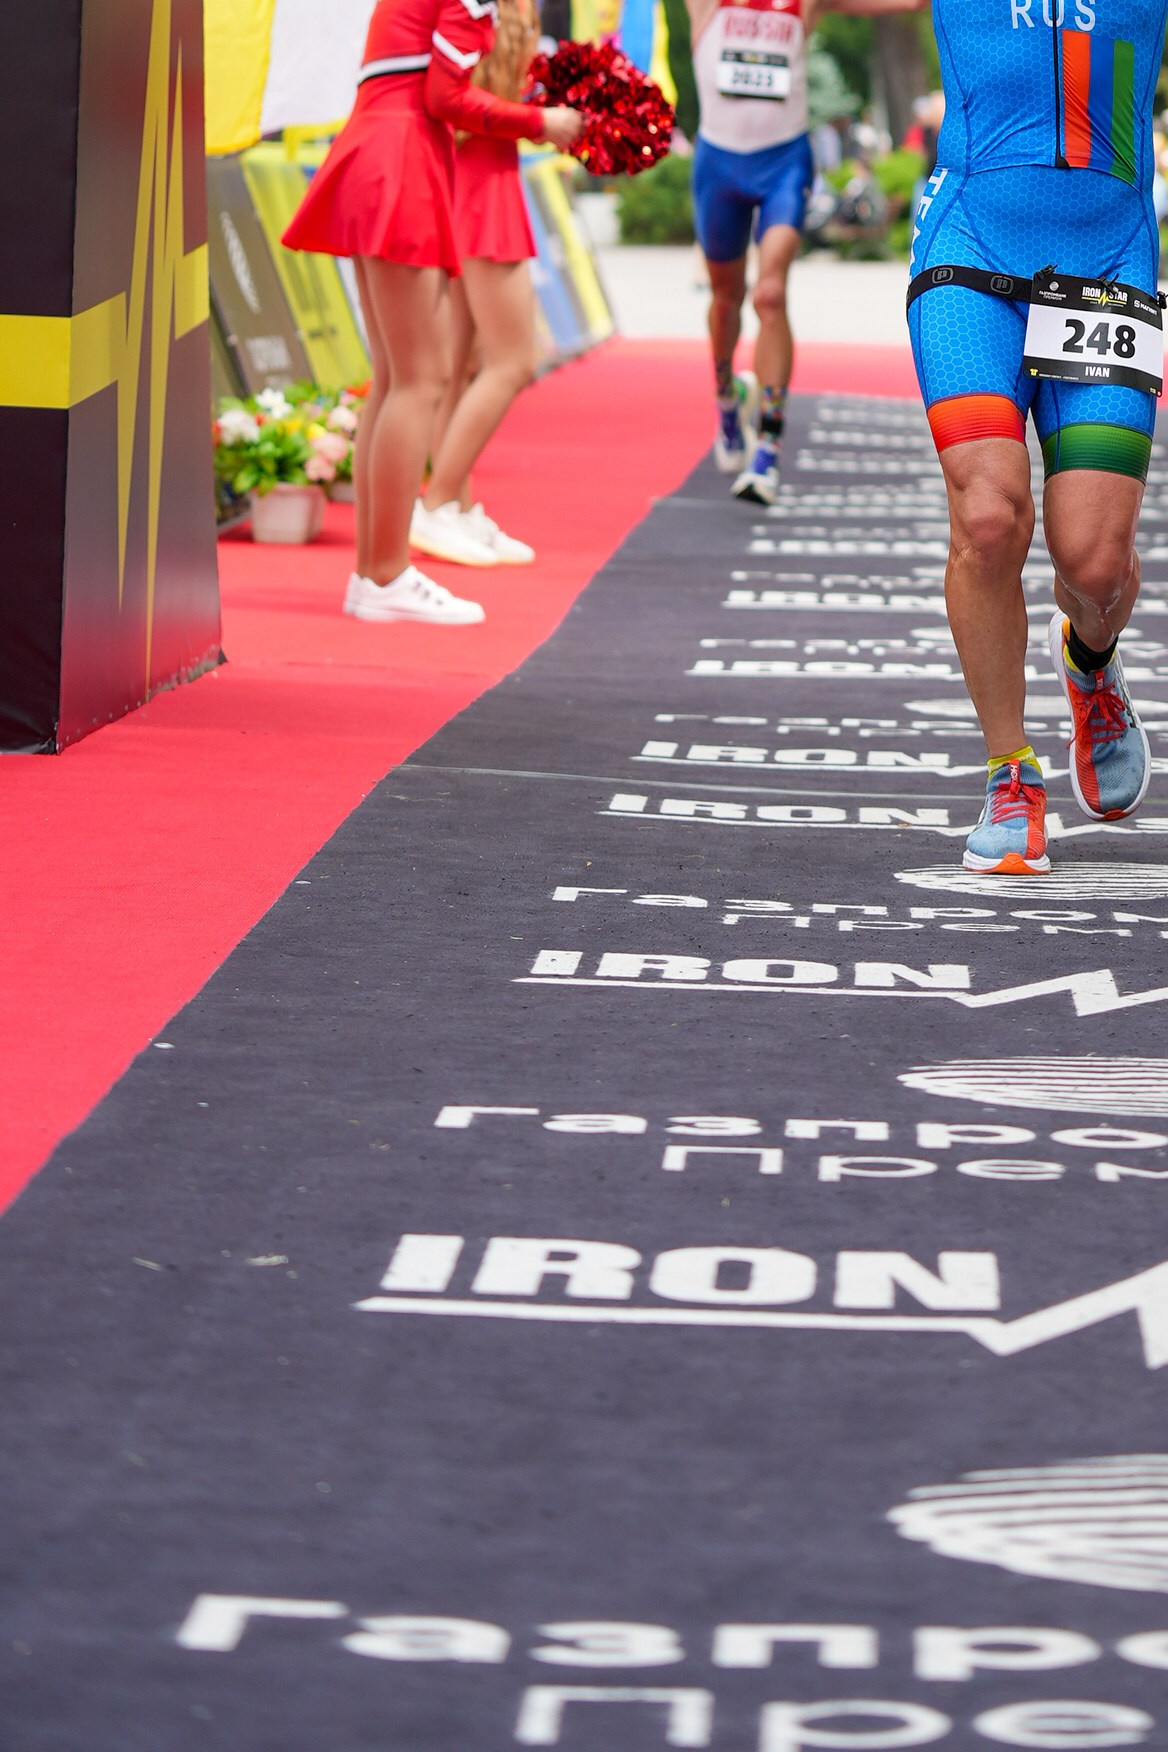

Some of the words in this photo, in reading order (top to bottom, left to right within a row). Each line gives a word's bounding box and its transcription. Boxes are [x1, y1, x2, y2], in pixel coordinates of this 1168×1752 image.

[1082, 286, 1101, 298] IRON
[1062, 318, 1136, 359] 248
[1084, 365, 1110, 378] IVAN
[639, 740, 950, 768] IRON
[608, 793, 951, 827] IRON
[529, 949, 971, 990] IRON
[378, 1233, 1001, 1311] IRON
